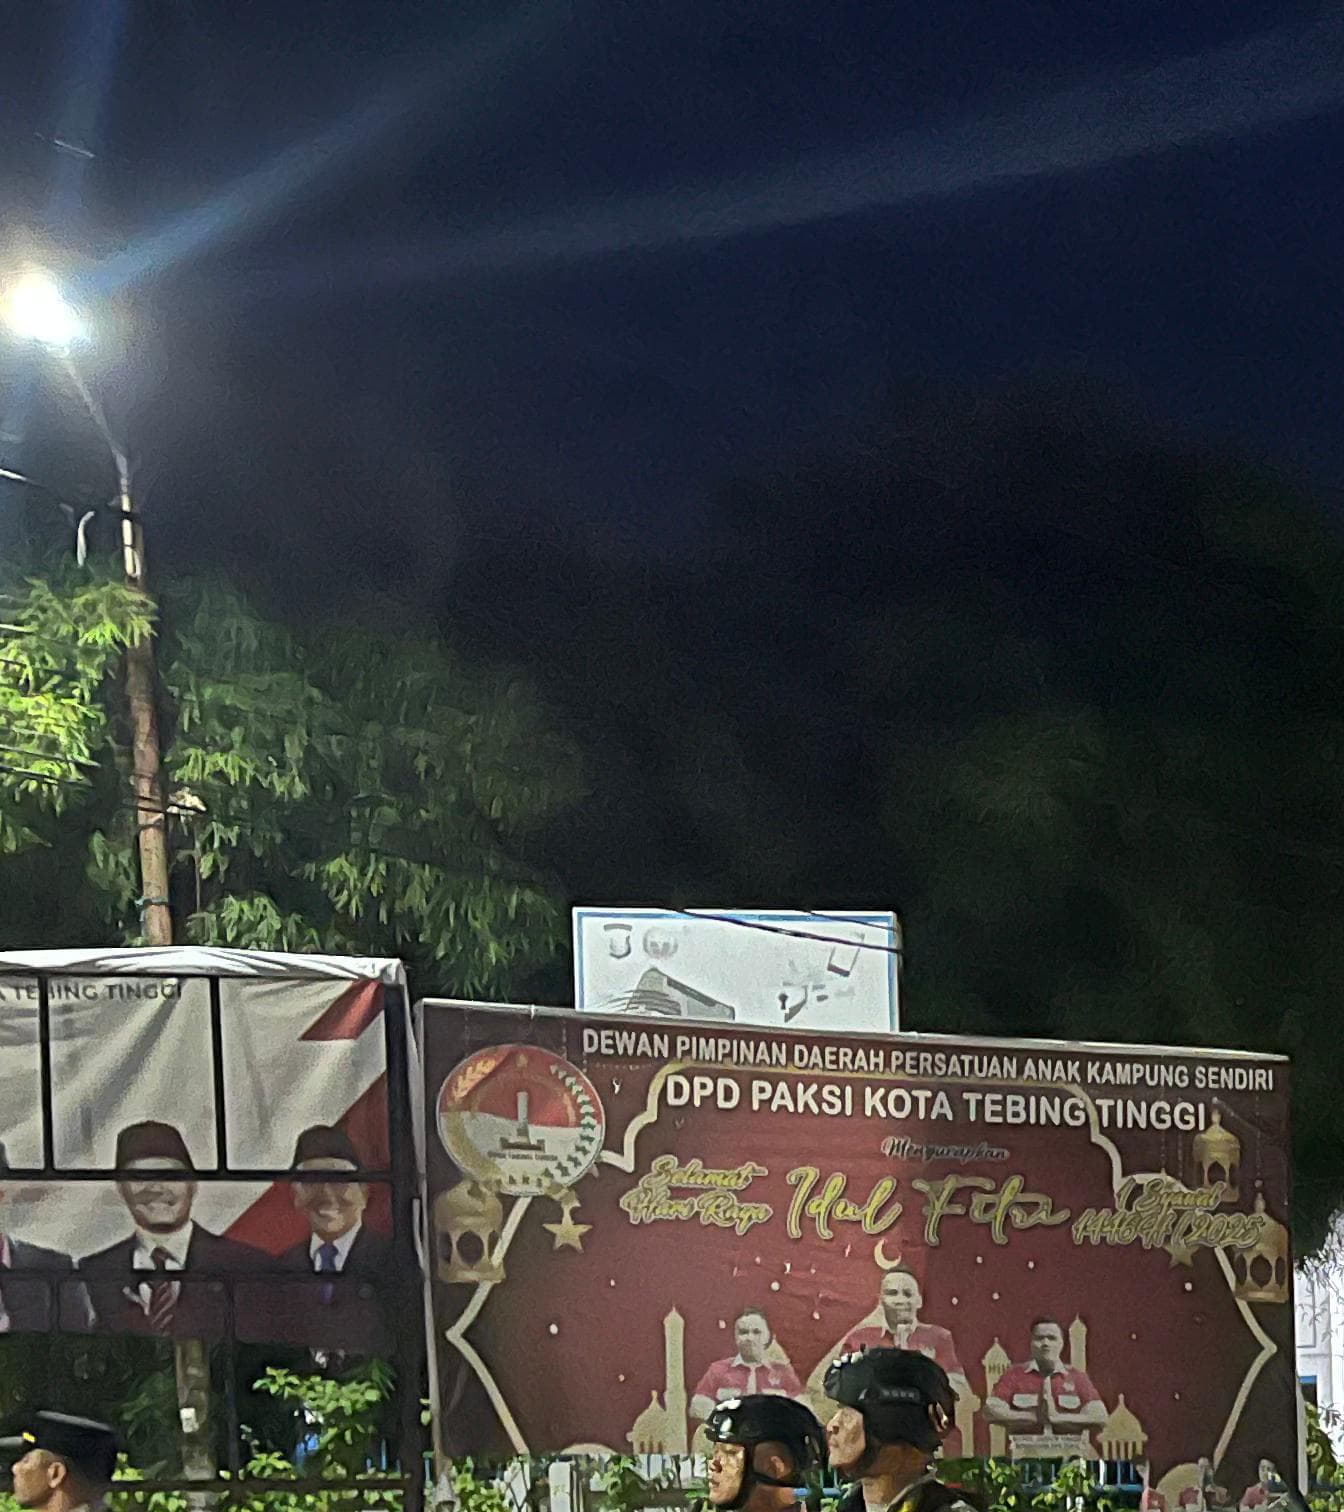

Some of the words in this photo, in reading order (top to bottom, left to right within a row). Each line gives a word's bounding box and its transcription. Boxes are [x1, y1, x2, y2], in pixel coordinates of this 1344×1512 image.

[15, 982, 99, 1000] TEING
[106, 978, 182, 1000] TINGGI
[583, 1029, 669, 1058] DEWAN
[676, 1036, 786, 1066] PIMPINAN
[794, 1044, 884, 1072] DAERAH
[891, 1050, 1018, 1080] PERSATUAN
[1023, 1059, 1081, 1083] ANAK
[1087, 1060, 1189, 1088] KAMPUNG
[1195, 1065, 1274, 1092] SENDIRI
[667, 1075, 740, 1110] DPD
[752, 1080, 852, 1117] PAKSI
[864, 1086, 953, 1121] KOTA
[962, 1092, 1086, 1127] TEBING
[1100, 1099, 1205, 1131] TINGGI
[640, 1154, 768, 1189] Selamat
[620, 1182, 696, 1225] Hari
[697, 1190, 773, 1236] Raya
[786, 1166, 902, 1240] Idul
[911, 1173, 1071, 1246] Fitri
